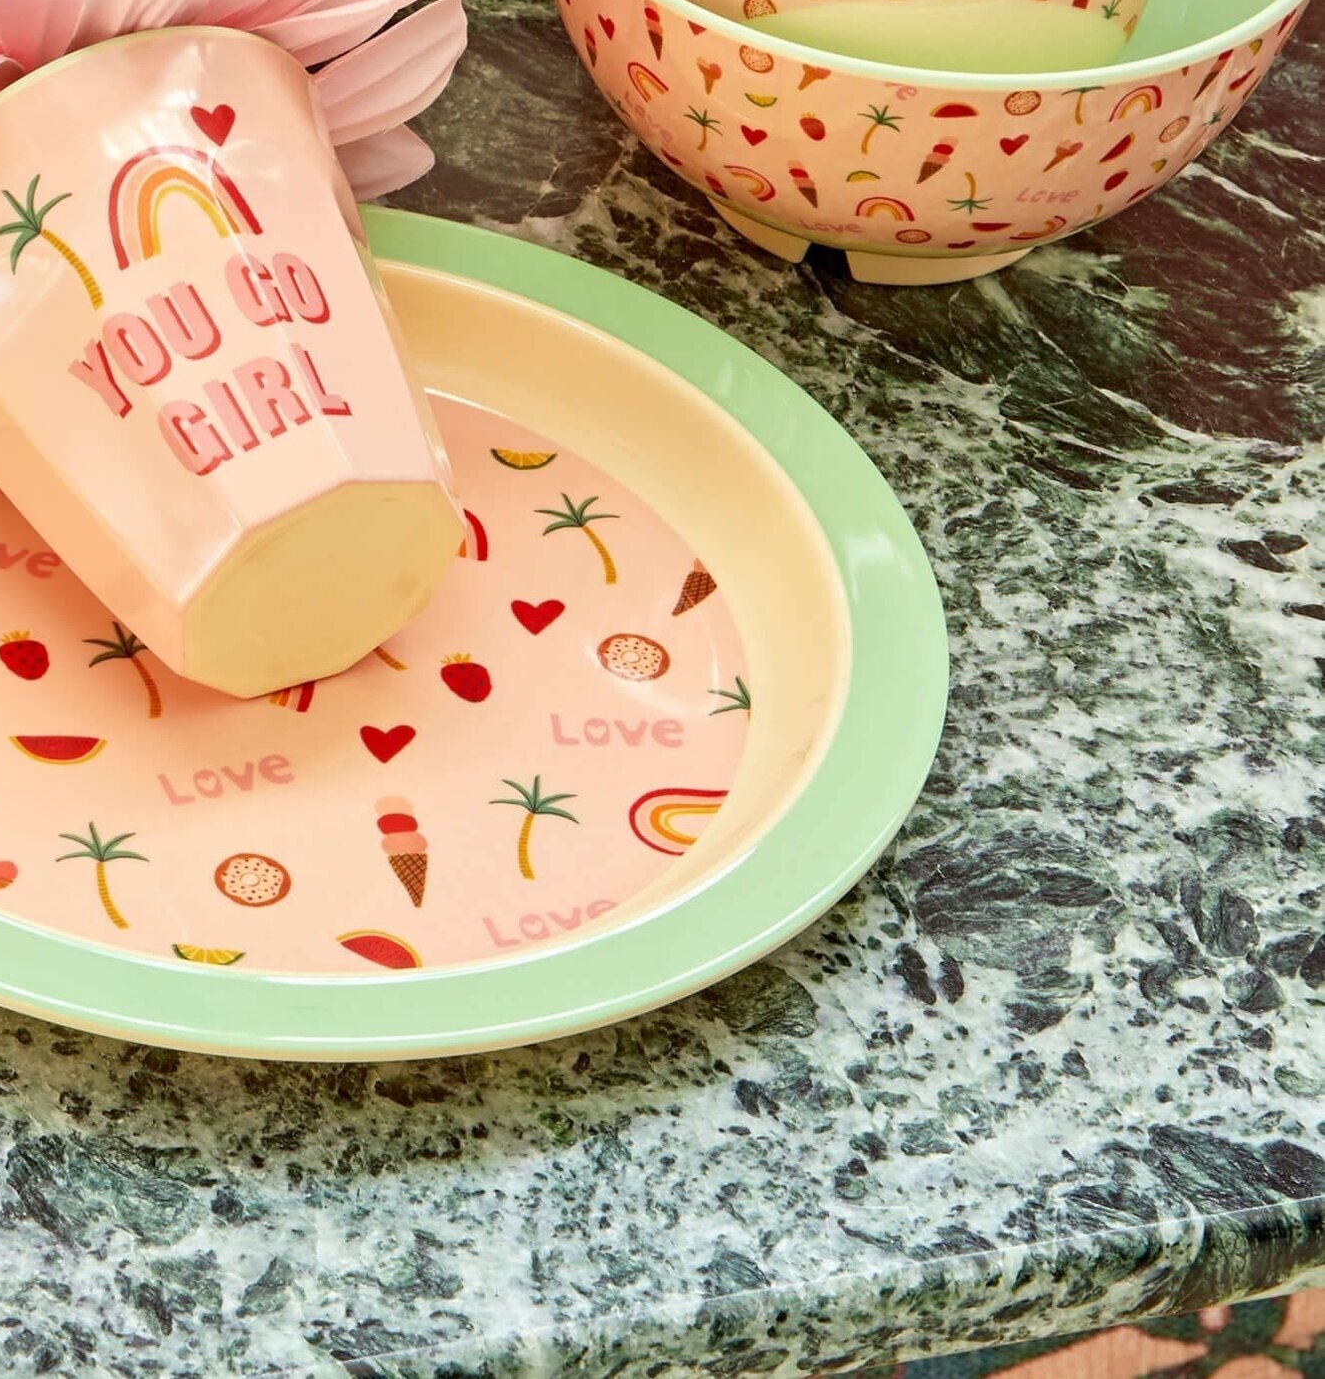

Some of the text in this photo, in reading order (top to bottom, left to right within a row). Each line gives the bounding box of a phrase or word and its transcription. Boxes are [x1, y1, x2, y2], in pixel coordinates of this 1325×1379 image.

[1015, 187, 1080, 203] Love
[799, 219, 862, 234] Love
[67, 252, 330, 419] YOU GO
[157, 342, 353, 476] GIRL
[551, 713, 684, 748] Love
[157, 753, 295, 806] Love
